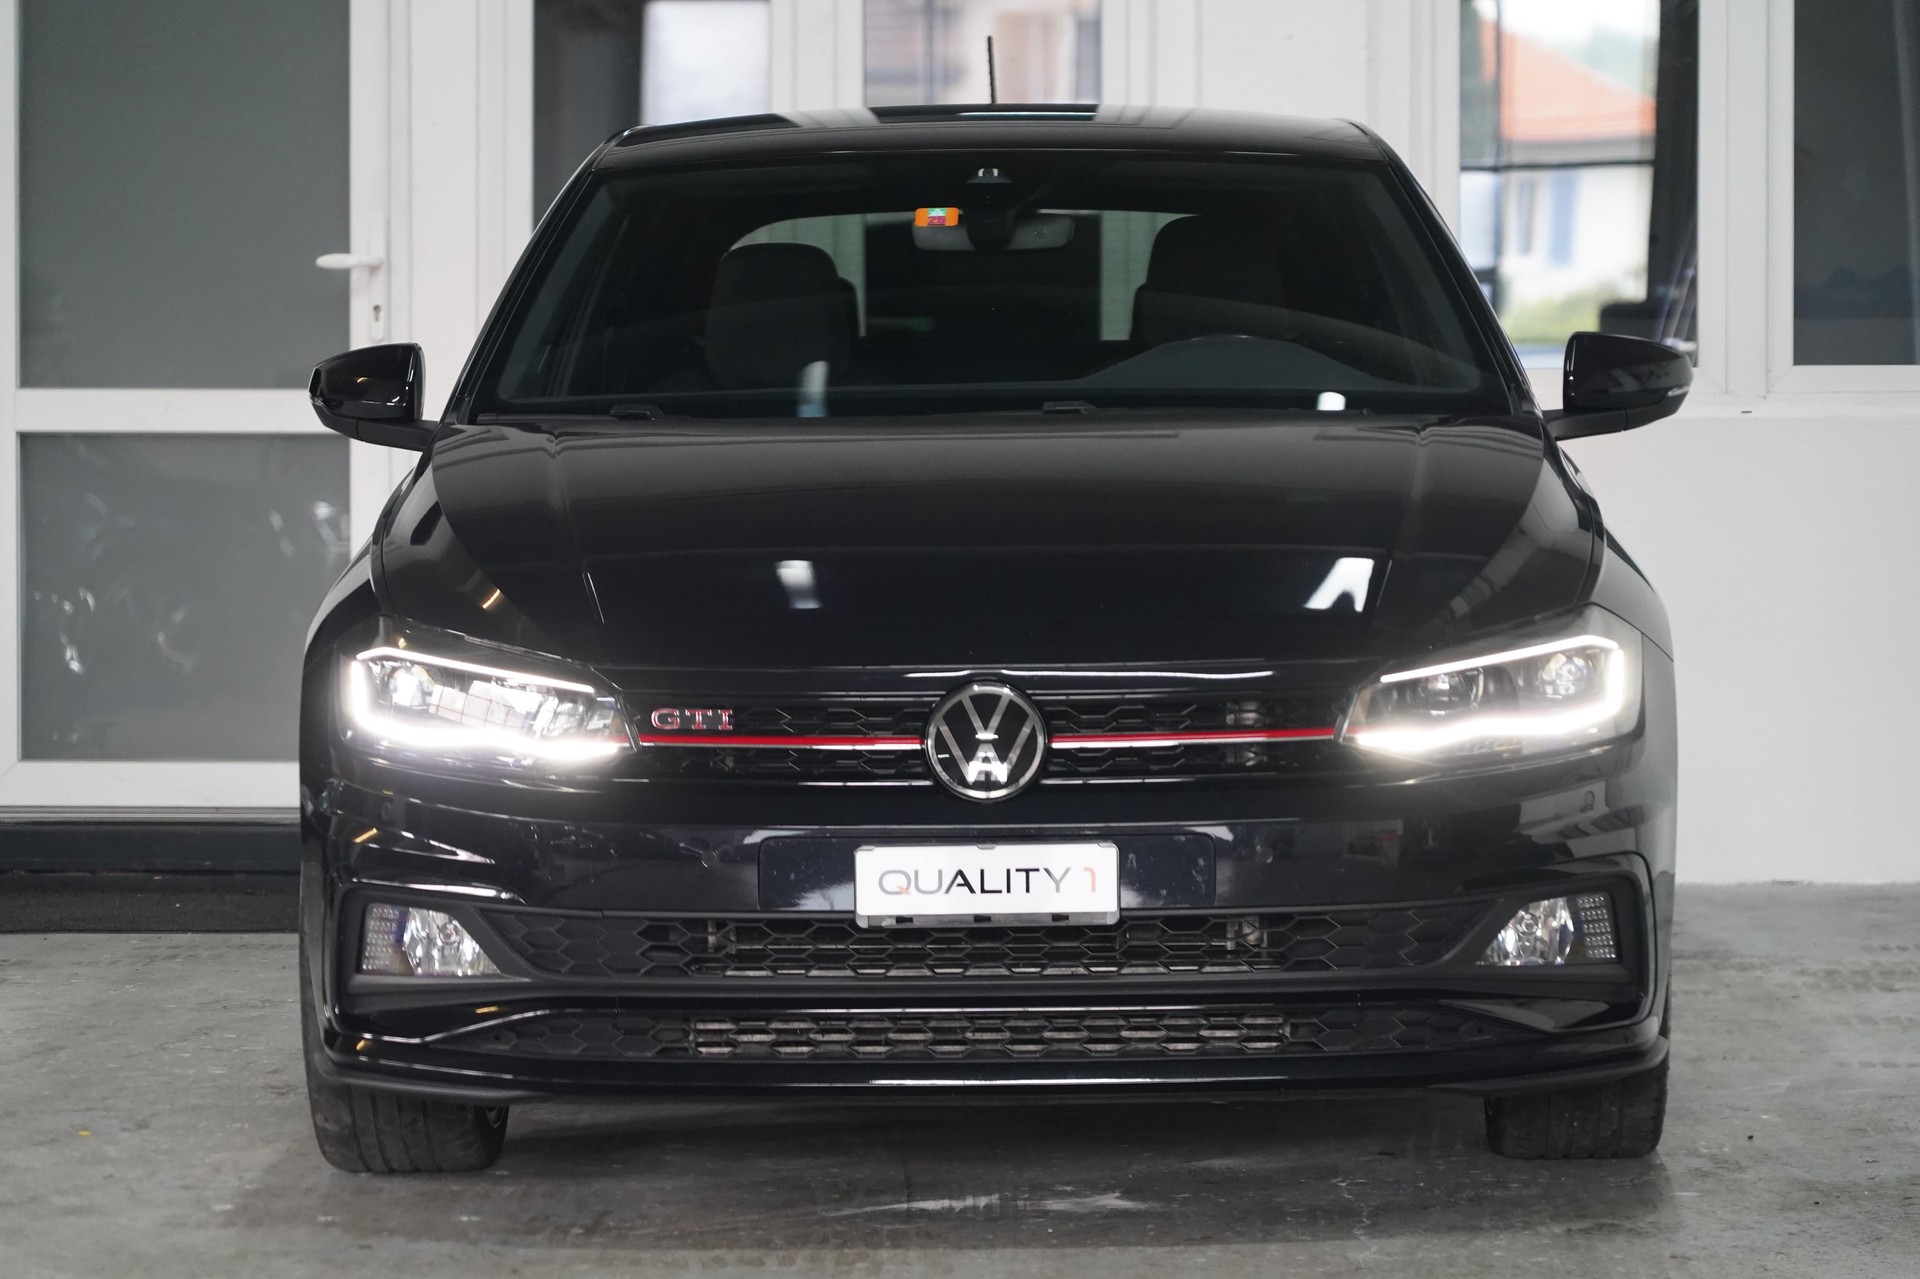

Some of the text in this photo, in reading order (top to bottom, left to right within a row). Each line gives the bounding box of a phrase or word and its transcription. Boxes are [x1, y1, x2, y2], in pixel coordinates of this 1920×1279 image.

[651, 708, 733, 730] GTI
[878, 867, 1097, 895] QUALITY 1
